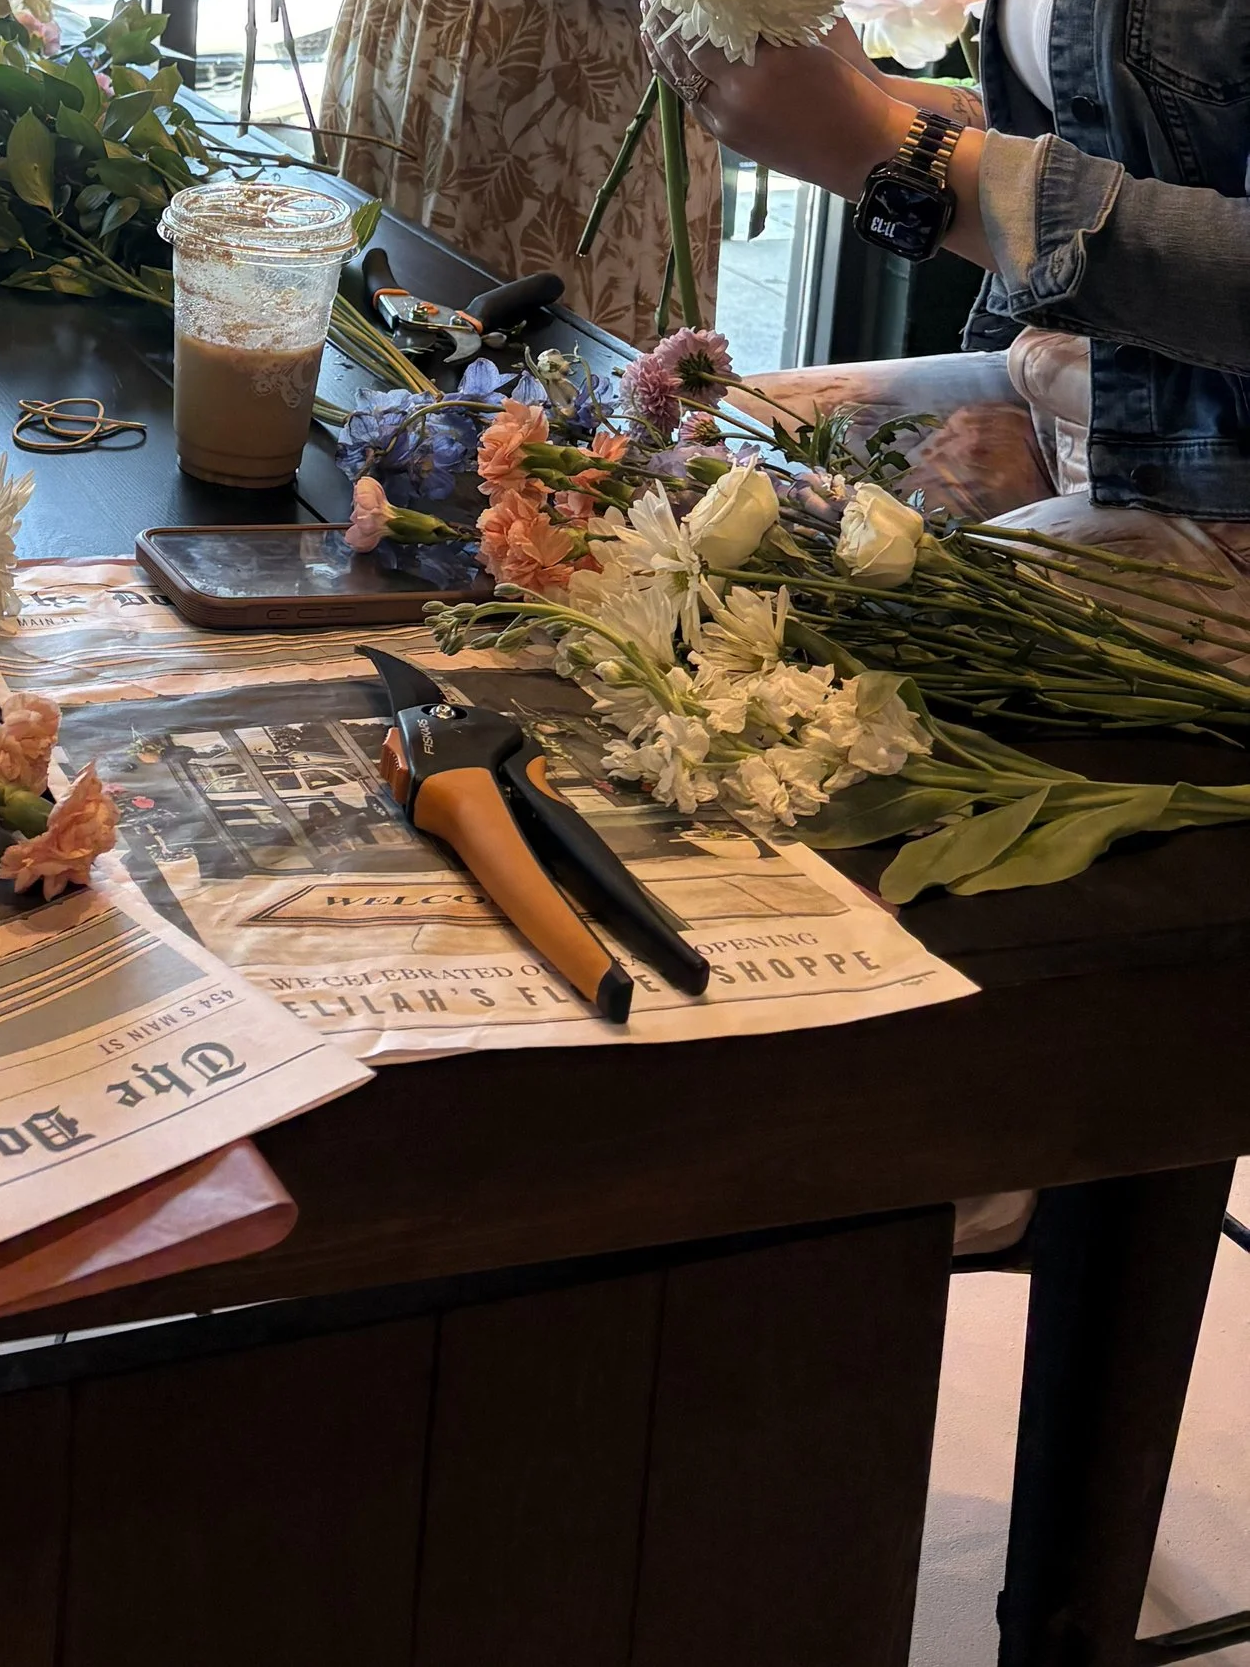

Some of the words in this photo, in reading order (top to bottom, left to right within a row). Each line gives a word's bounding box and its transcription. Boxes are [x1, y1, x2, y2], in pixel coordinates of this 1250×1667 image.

[870, 216, 896, 238] 11:13
[16, 618, 55, 627] MAIN
[416, 718, 435, 755] FISKARS
[326, 894, 486, 907] WELCO
[270, 977, 317, 991] WE
[322, 965, 514, 988] CELEBRATED
[694, 932, 819, 956] OPENING
[281, 986, 496, 1020] ELILAH'S
[709, 950, 881, 985] SHOPPE
[199, 989, 235, 1009] 454
[180, 1006, 196, 1017] S
[127, 1014, 179, 1042] MAIN
[98, 1038, 125, 1056] ST
[106, 1042, 247, 1109] The
